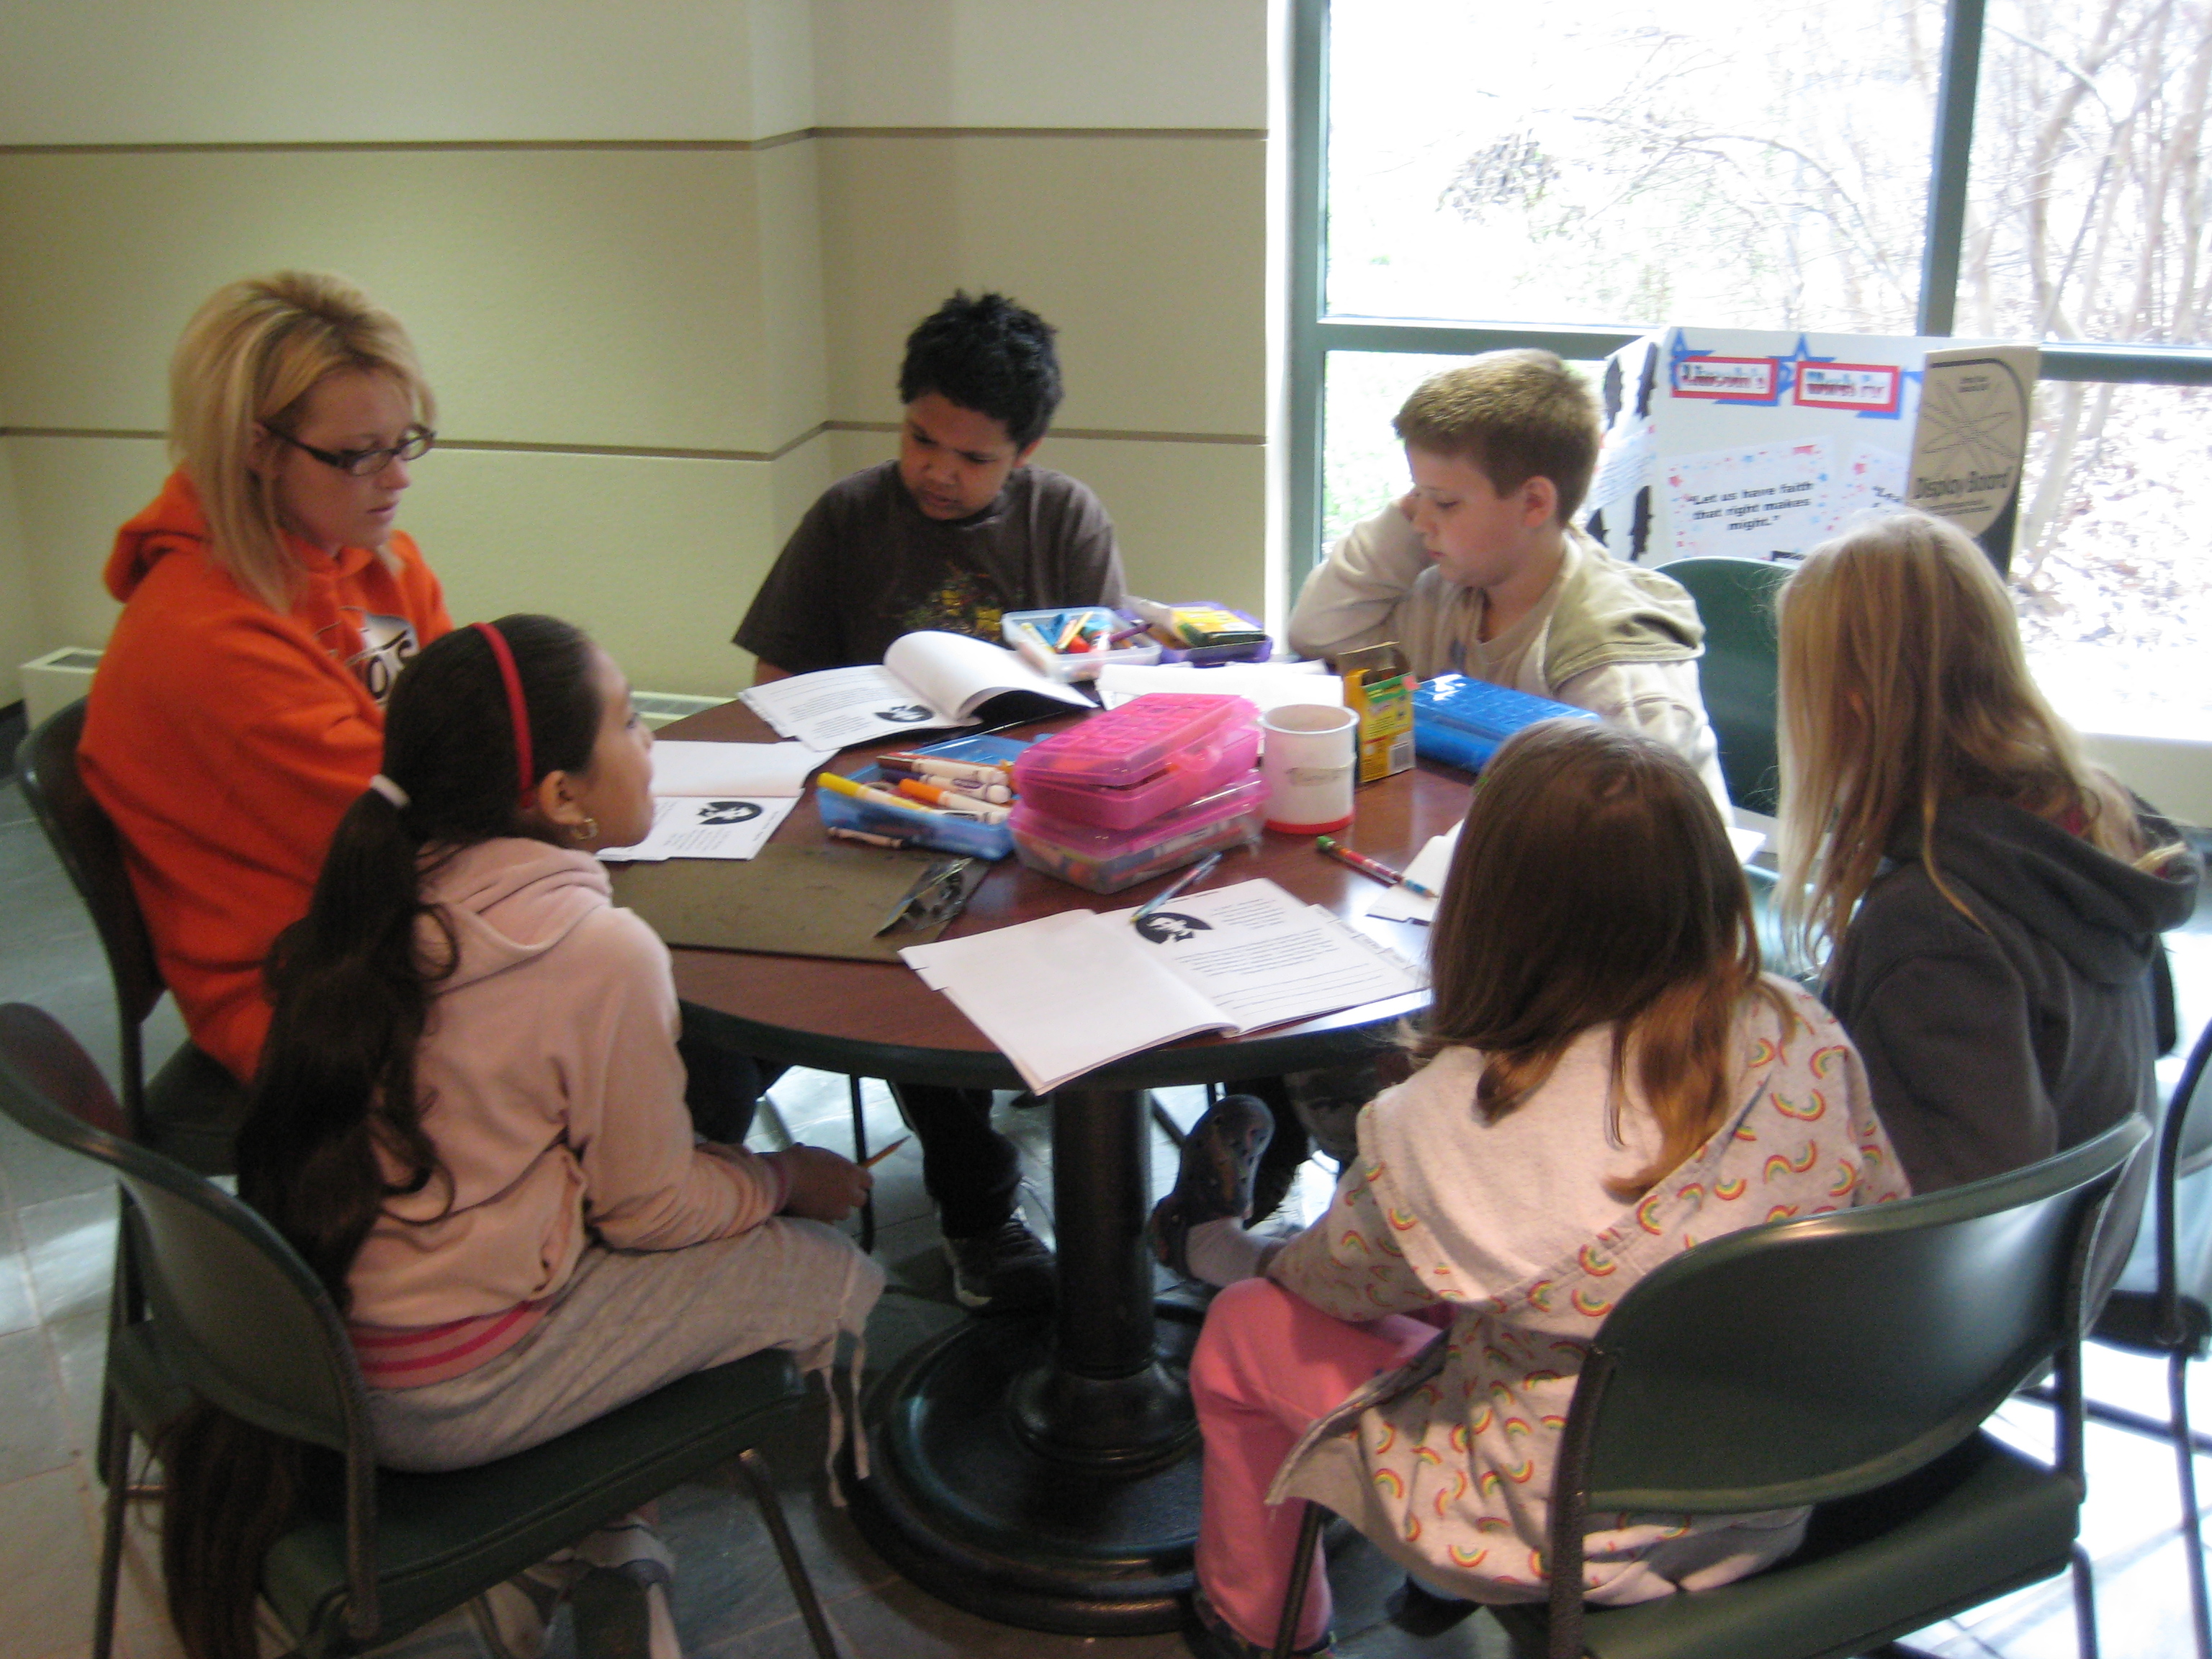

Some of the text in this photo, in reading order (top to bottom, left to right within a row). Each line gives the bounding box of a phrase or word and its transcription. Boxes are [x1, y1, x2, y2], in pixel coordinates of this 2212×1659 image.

[1681, 364, 1766, 390] Lincoln's
[1719, 492, 1738, 502] us
[1741, 488, 1776, 499] have
[1779, 481, 1814, 494] faith
[1966, 467, 2012, 493] Board
[1693, 498, 1812, 520] that right makes
